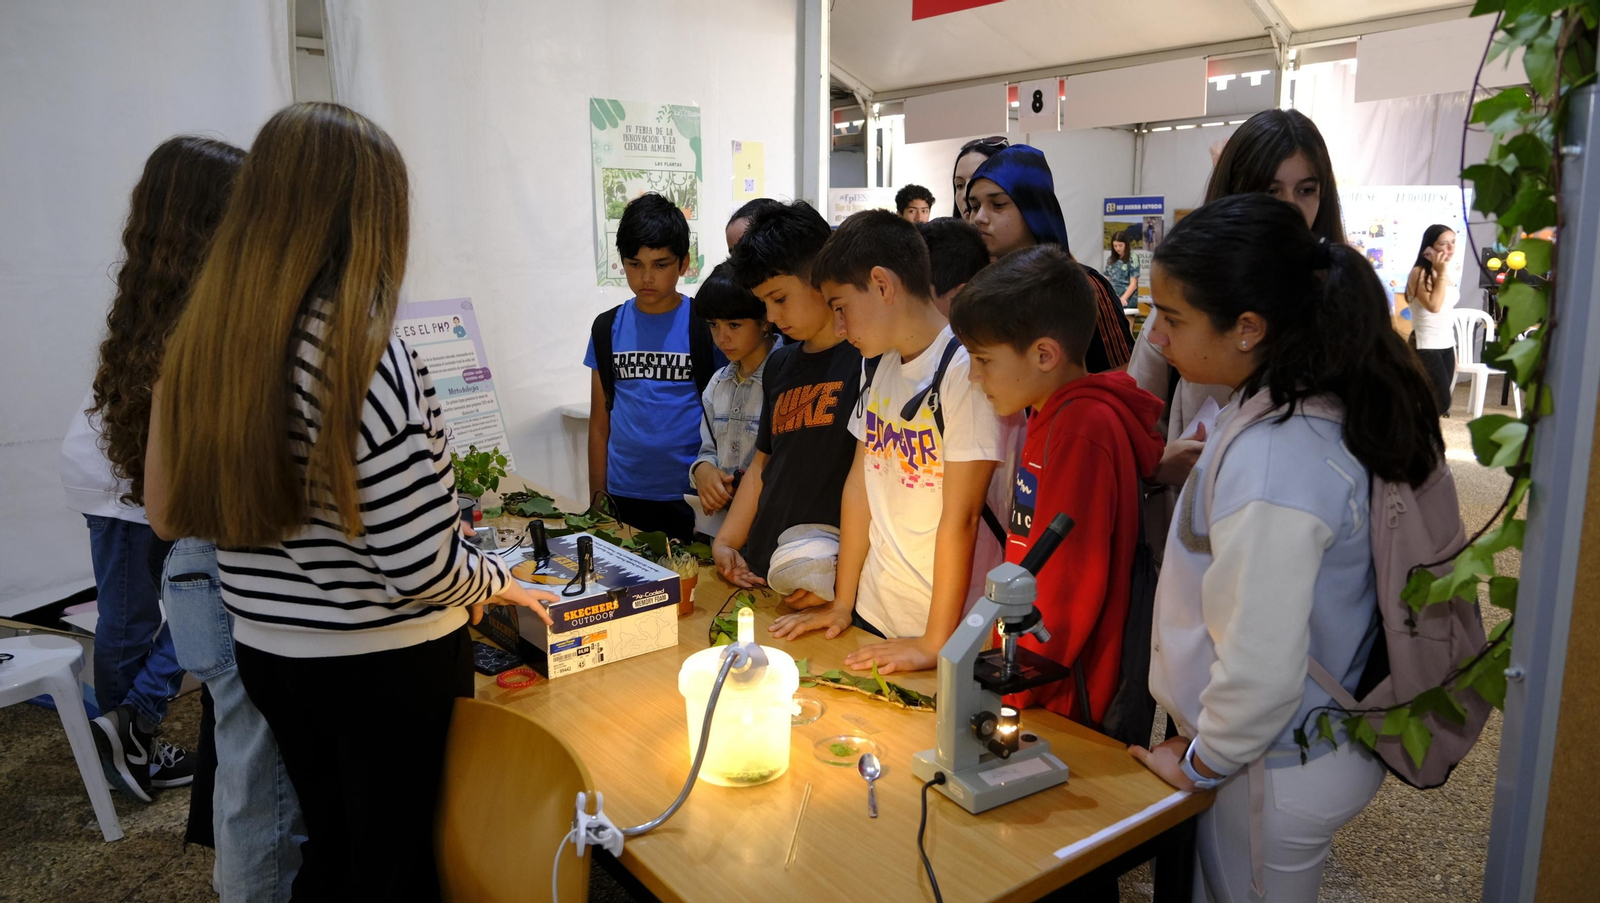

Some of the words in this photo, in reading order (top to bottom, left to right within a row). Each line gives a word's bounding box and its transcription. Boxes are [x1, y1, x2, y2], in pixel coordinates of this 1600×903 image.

[1031, 89, 1043, 114] 8
[626, 124, 632, 133] IV
[636, 126, 652, 134] FERIA
[656, 127, 664, 136] DE
[666, 127, 673, 136] LA
[624, 142, 648, 152] CIENCIA
[669, 136, 676, 144] LA
[403, 326, 416, 337] ES
[418, 324, 430, 335] EL
[432, 321, 450, 334] PH?
[772, 380, 844, 436] NIKE
[445, 426, 455, 441] 2
[634, 597, 654, 608] MEMORY
[654, 594, 667, 603] FOAM
[563, 600, 619, 622] SKECHERS
[571, 610, 615, 627] OUTDOOR
